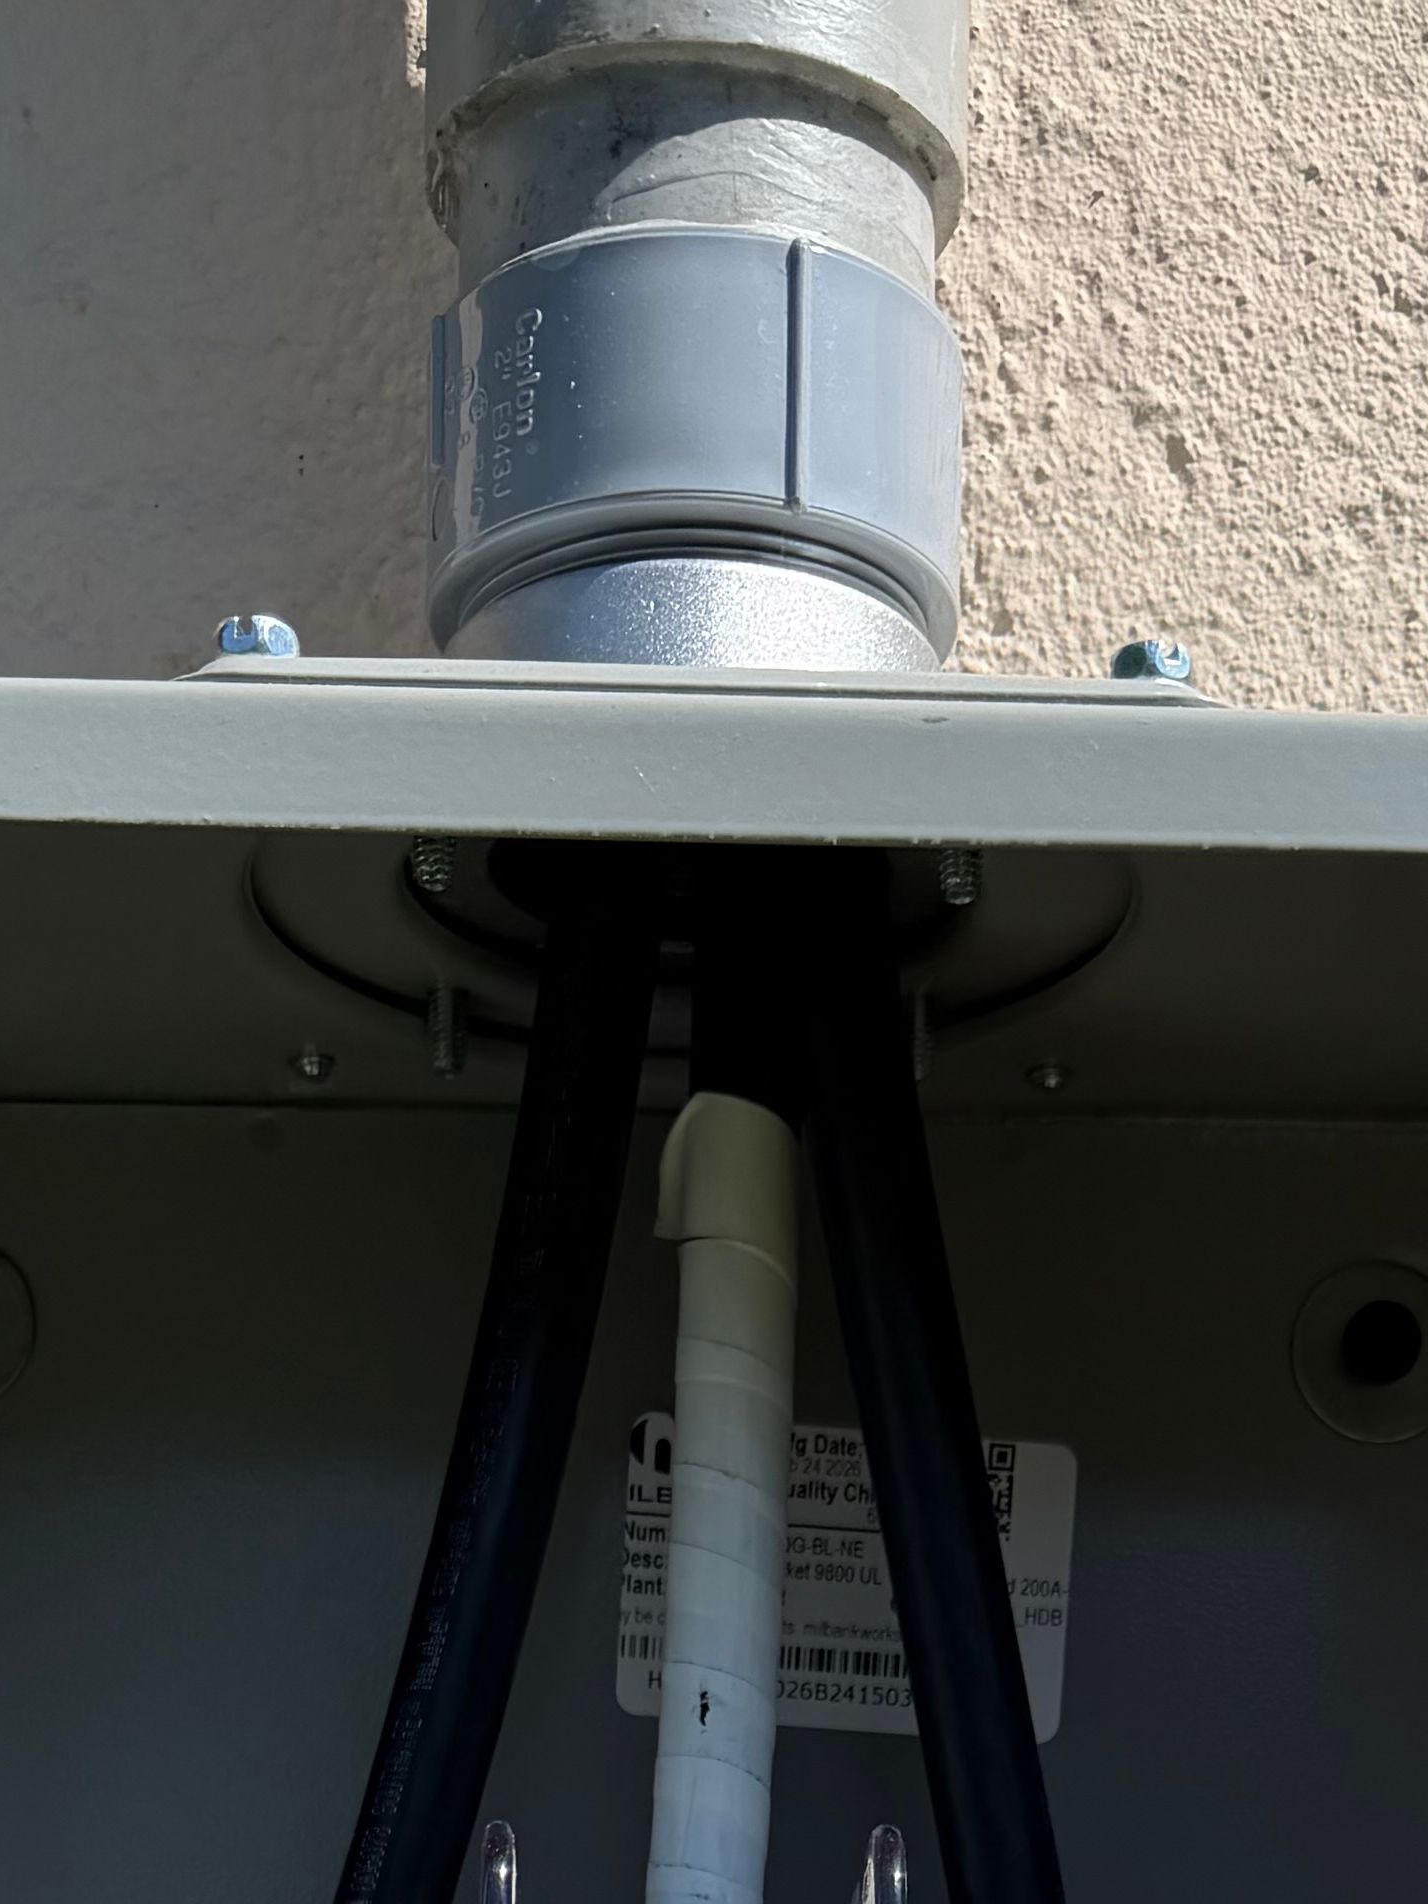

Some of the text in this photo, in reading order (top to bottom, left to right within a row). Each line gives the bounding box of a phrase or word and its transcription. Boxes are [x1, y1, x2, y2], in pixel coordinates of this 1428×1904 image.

[515, 307, 543, 437] Carlon
[814, 1563, 855, 1584] 9800
[858, 1565, 883, 1586] UL
